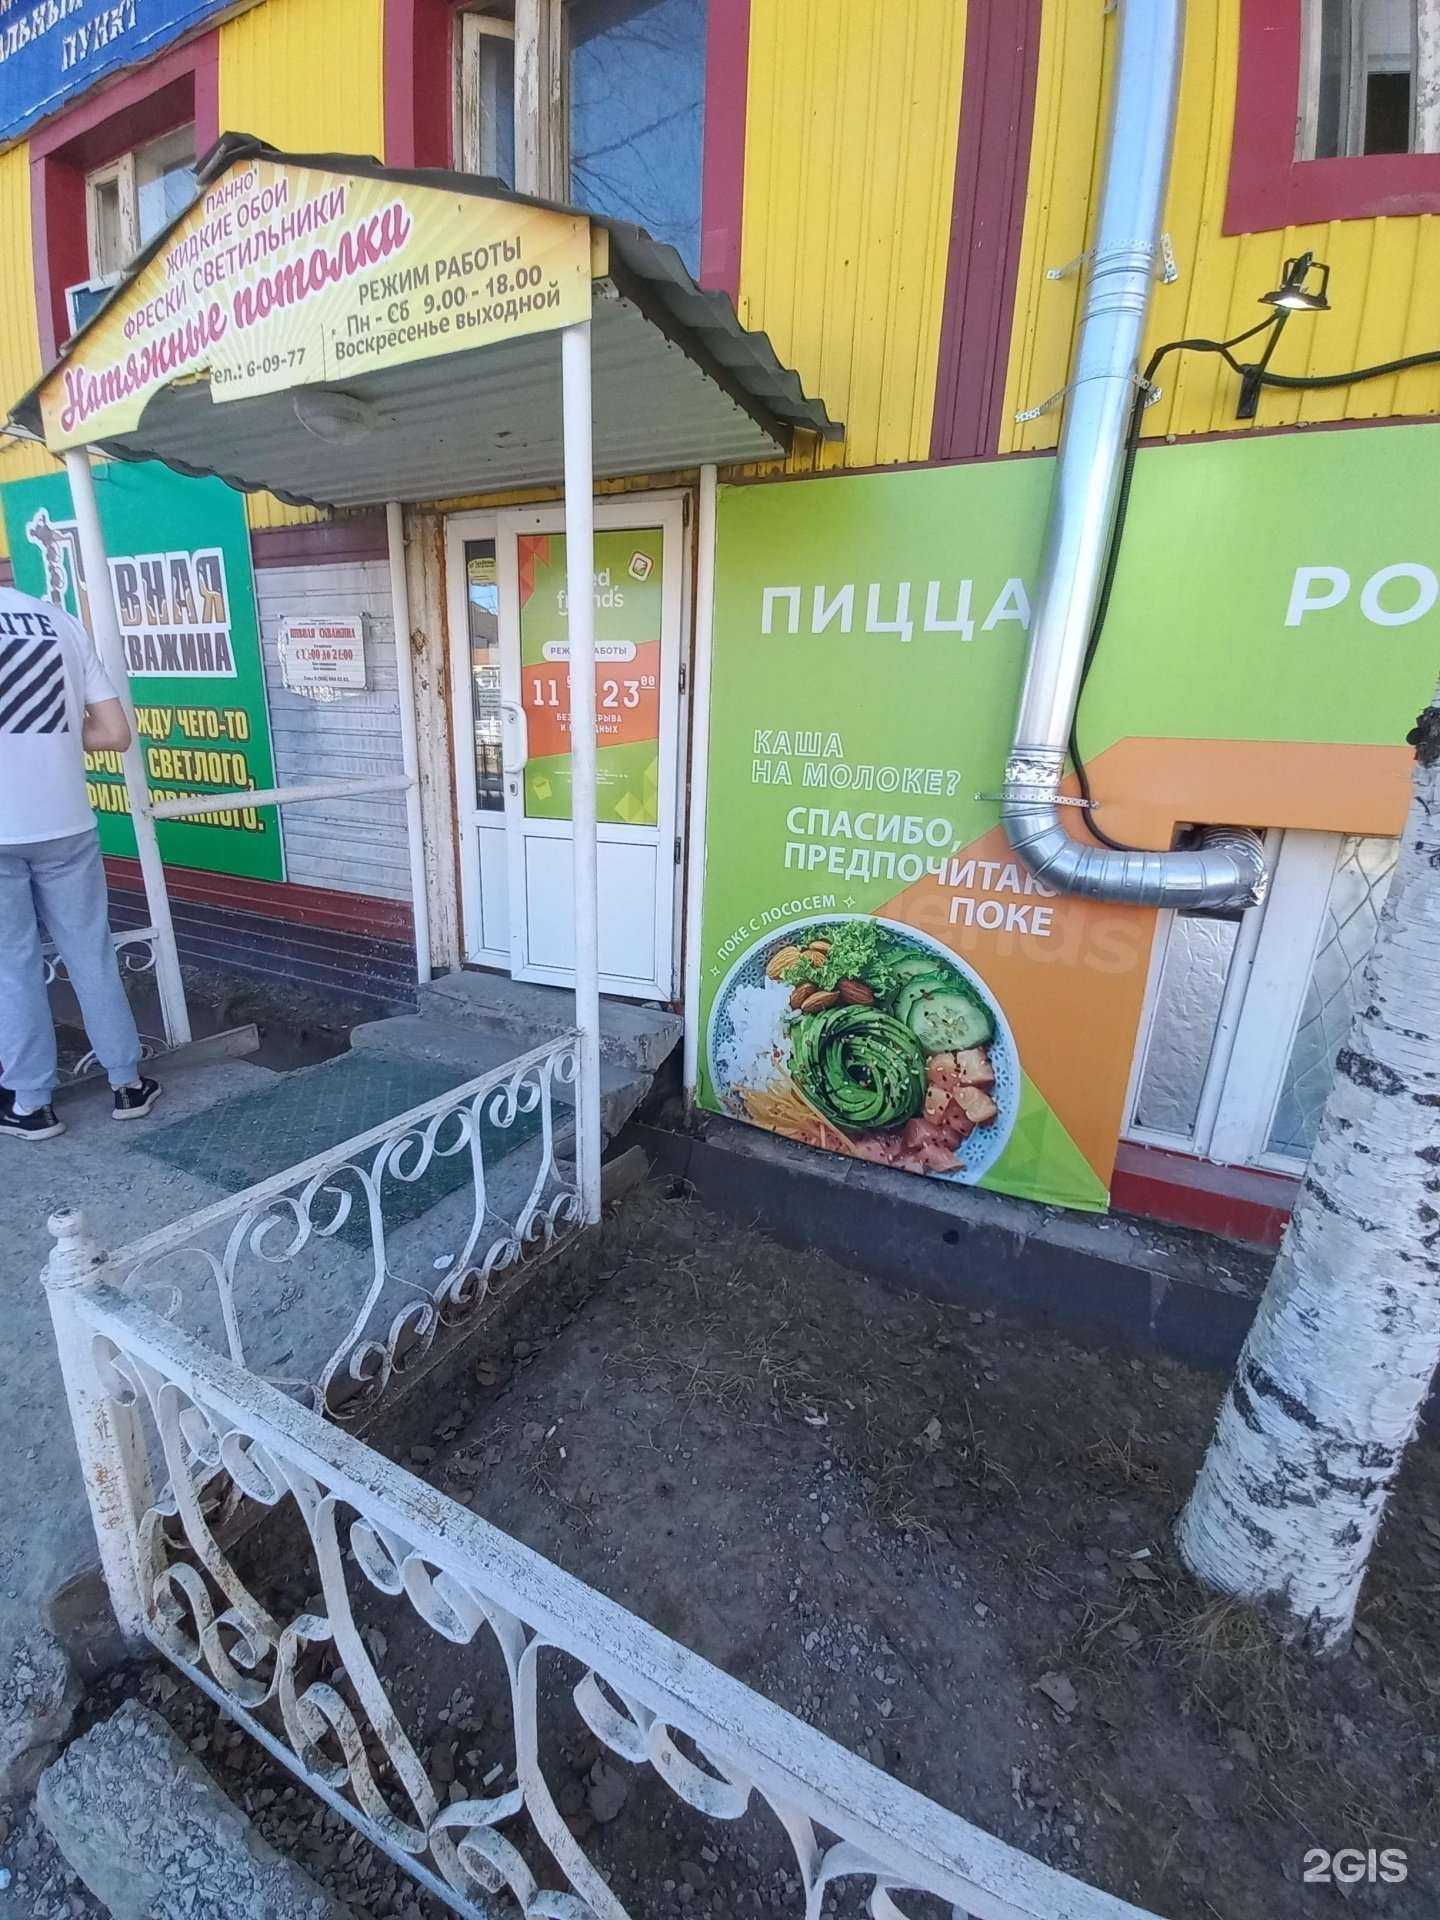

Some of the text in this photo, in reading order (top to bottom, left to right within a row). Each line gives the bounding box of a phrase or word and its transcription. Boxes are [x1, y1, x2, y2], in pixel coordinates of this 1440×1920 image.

[62, 0, 137, 73] ПУНКТ
[206, 174, 254, 214] ПАННО
[166, 180, 288, 279] ЖИДКИЕ ОБОИ
[123, 186, 345, 339] ФРЕСКИ СВЕТИЛЬНИКИ
[359, 237, 522, 306] РЕЖИМ РАБОТЫ
[61, 204, 411, 432] Натяжные потолки
[335, 283, 561, 361] Воскресенье выходной
[347, 314, 371, 338] Пн
[387, 300, 410, 325] Сб
[423, 287, 466, 315] 9.00
[486, 264, 543, 299] 18.00
[247, 347, 306, 377] 6-09-77
[27, 512, 226, 627] ПВНАЯ
[0, 612, 58, 637] ITE
[762, 578, 1031, 642] ПИЦЦА
[122, 632, 232, 671] ВАЖИНА
[550, 647, 627, 656] РЕЖ АБОТЫ
[533, 680, 560, 706] 11
[602, 680, 640, 708] 23
[176, 710, 249, 740] ЧЕГО-ТО
[753, 730, 844, 758] КАША
[148, 748, 254, 791] СВЕТЛОГО,
[751, 760, 961, 796] НА МОЛОКЕ?
[785, 807, 961, 852] СПАСИБО,
[717, 894, 836, 961] ПОКЕ С ЛОСОСЕМ
[949, 896, 1054, 937] ПОКЕ
